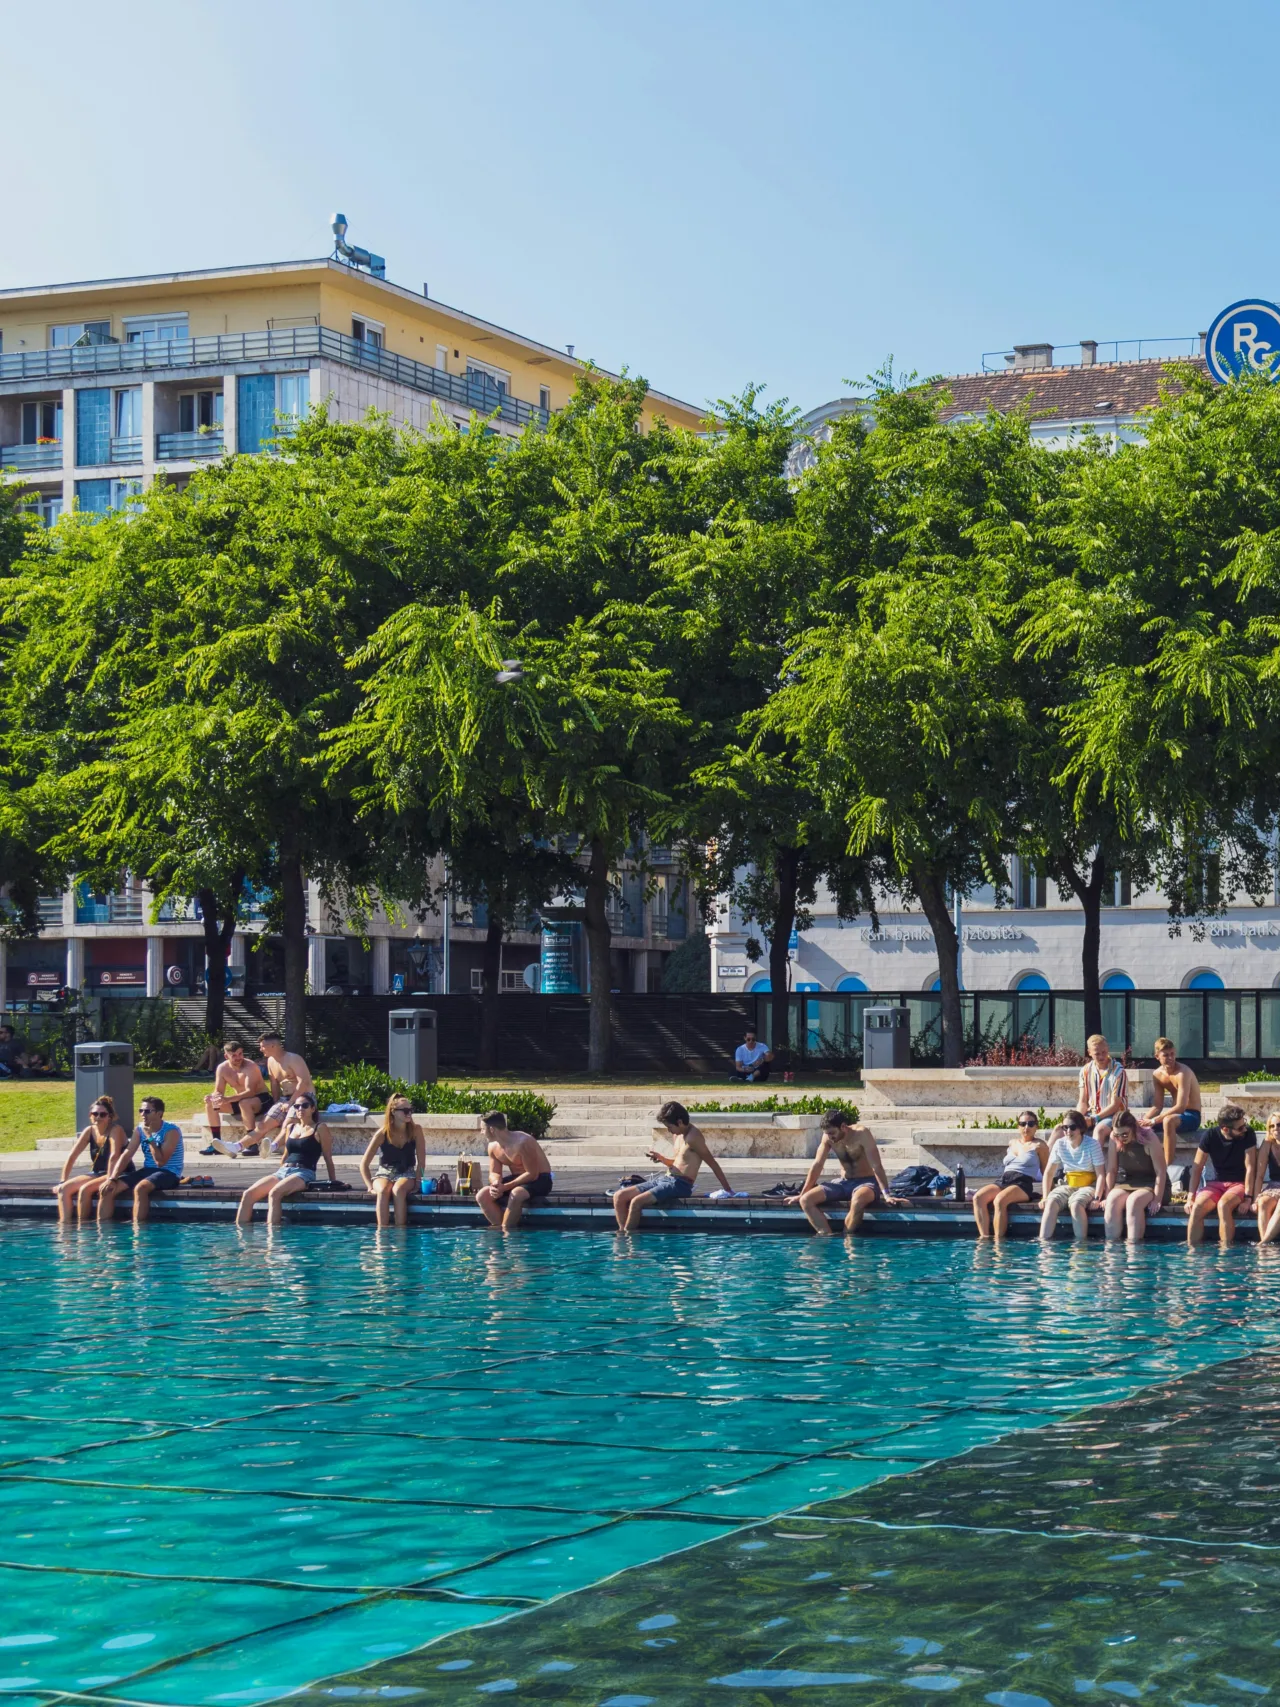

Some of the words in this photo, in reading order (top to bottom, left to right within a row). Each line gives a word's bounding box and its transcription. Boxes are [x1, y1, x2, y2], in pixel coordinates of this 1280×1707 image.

[860, 926, 887, 941] K&H
[895, 926, 929, 941] bank
[1240, 920, 1275, 936] bank
